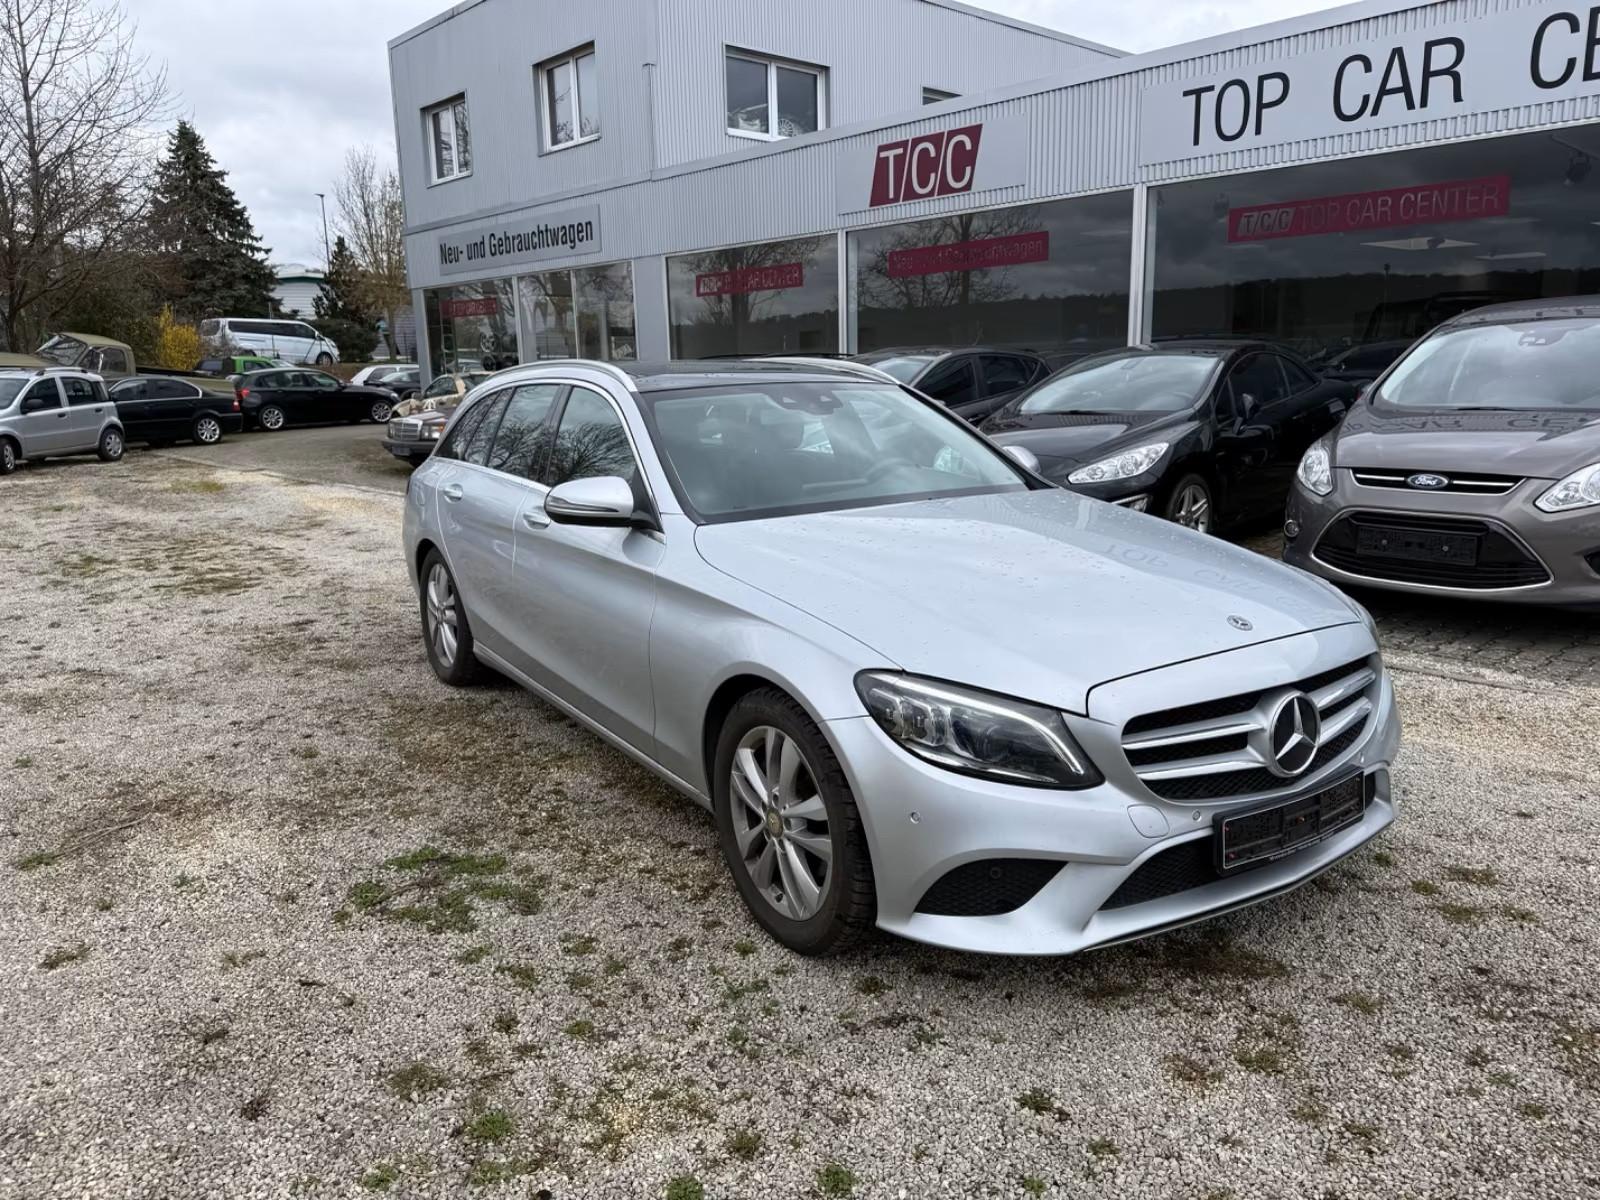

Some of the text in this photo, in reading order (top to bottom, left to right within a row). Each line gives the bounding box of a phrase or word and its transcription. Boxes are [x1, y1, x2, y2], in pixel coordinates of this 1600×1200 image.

[1182, 71, 1290, 146] TOP
[1332, 36, 1465, 122] CAR
[1299, 201, 1340, 230] TOP
[1346, 195, 1393, 225] CAR
[1399, 185, 1499, 221] CENTER
[440, 220, 593, 264] Neu- und Gebrauchtwagen
[1414, 475, 1438, 486] Ford
